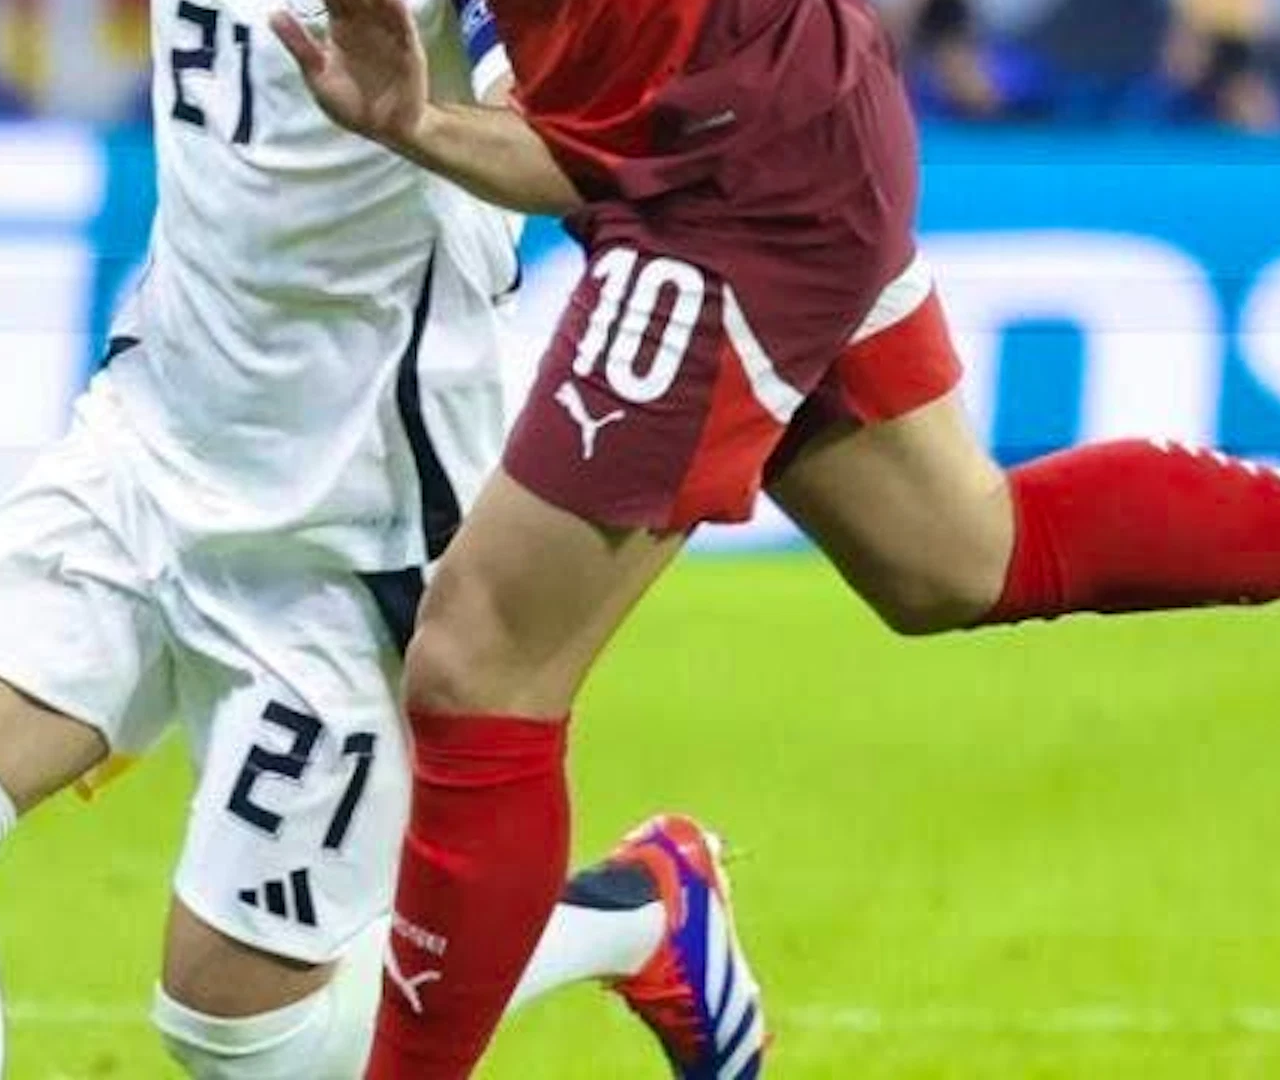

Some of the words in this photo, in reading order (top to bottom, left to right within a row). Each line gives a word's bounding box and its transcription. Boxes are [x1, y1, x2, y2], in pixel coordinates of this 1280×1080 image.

[172, 0, 253, 144] 21
[572, 247, 705, 404] 10
[227, 699, 376, 849] 21
